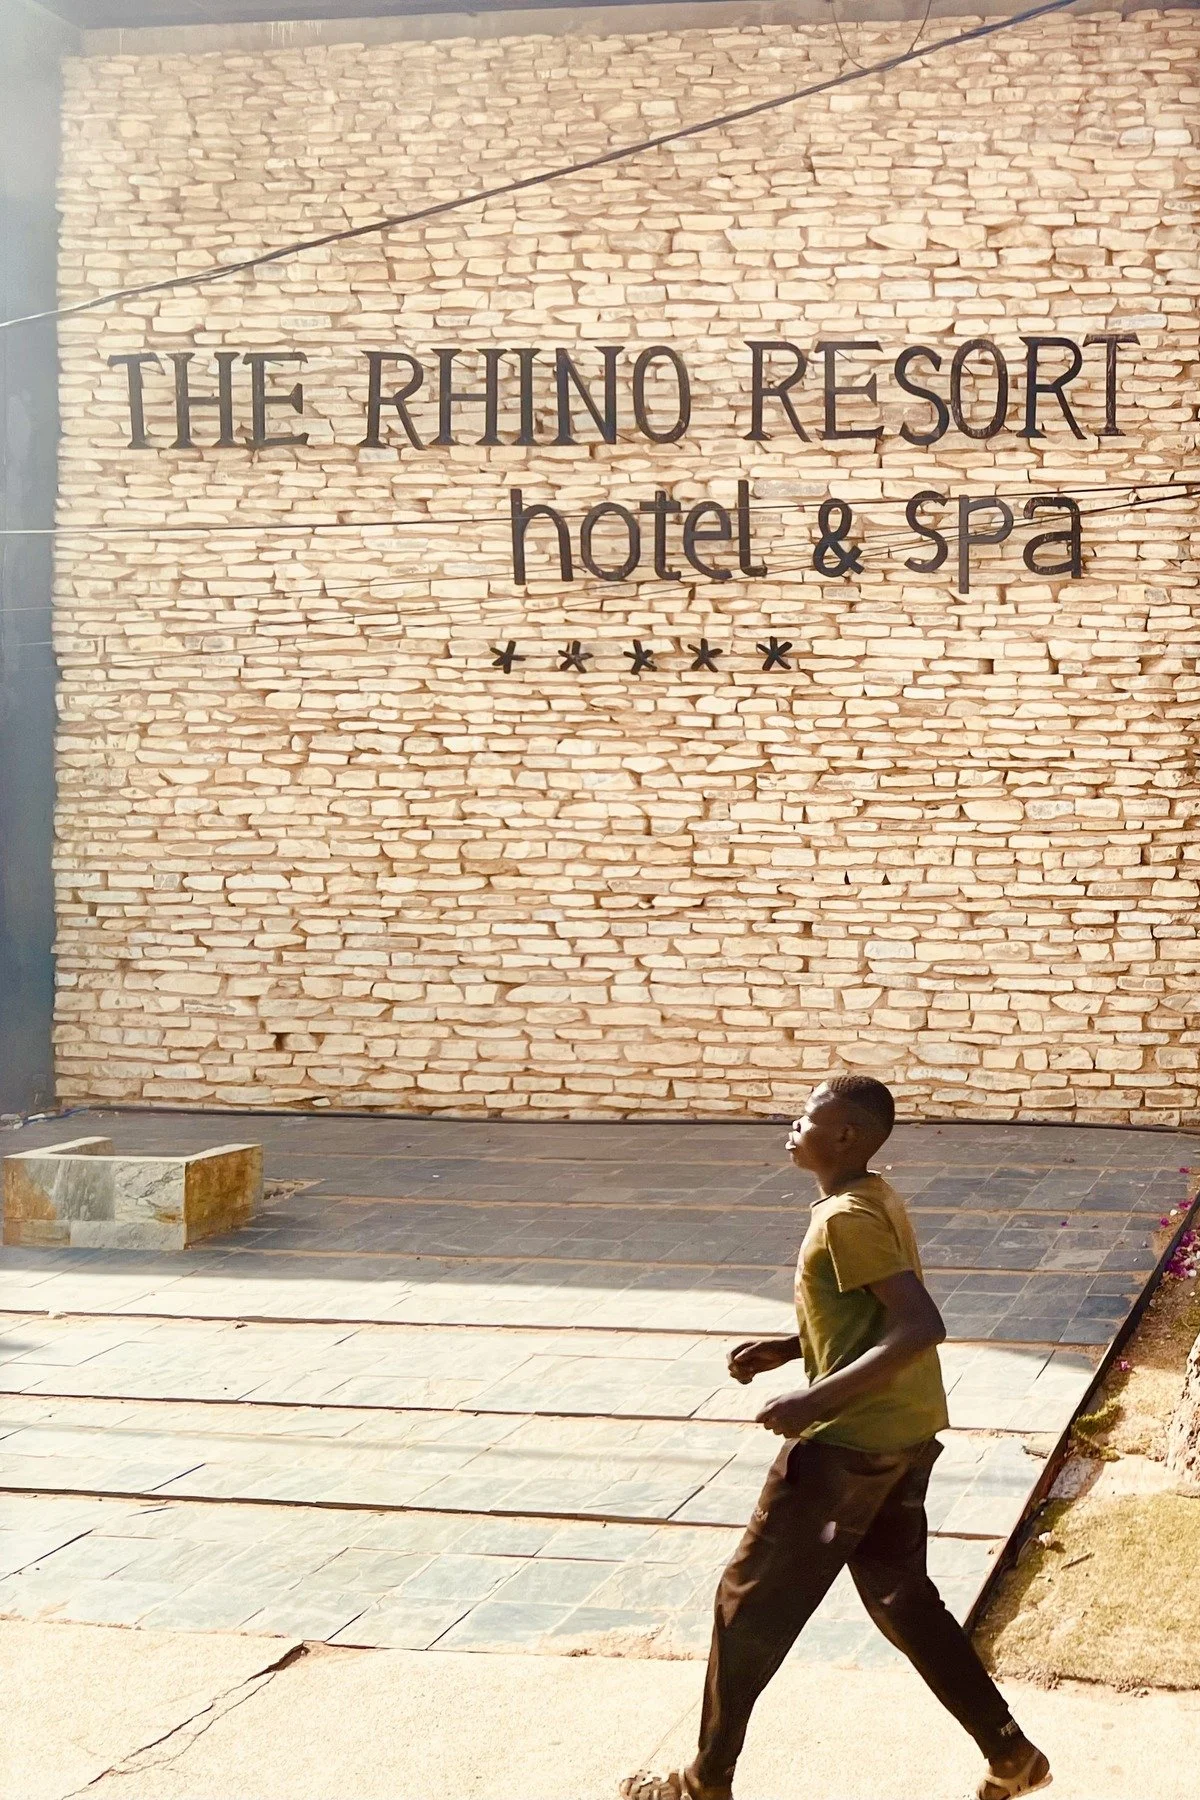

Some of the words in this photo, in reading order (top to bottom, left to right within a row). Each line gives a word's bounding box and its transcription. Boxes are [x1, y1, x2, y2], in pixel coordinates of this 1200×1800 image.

[108, 351, 309, 450] THE
[359, 345, 692, 450] RHINO
[743, 333, 1140, 446] RESORT
[510, 480, 768, 585] hotel
[813, 498, 866, 577] &
[904, 490, 1082, 594] spa
